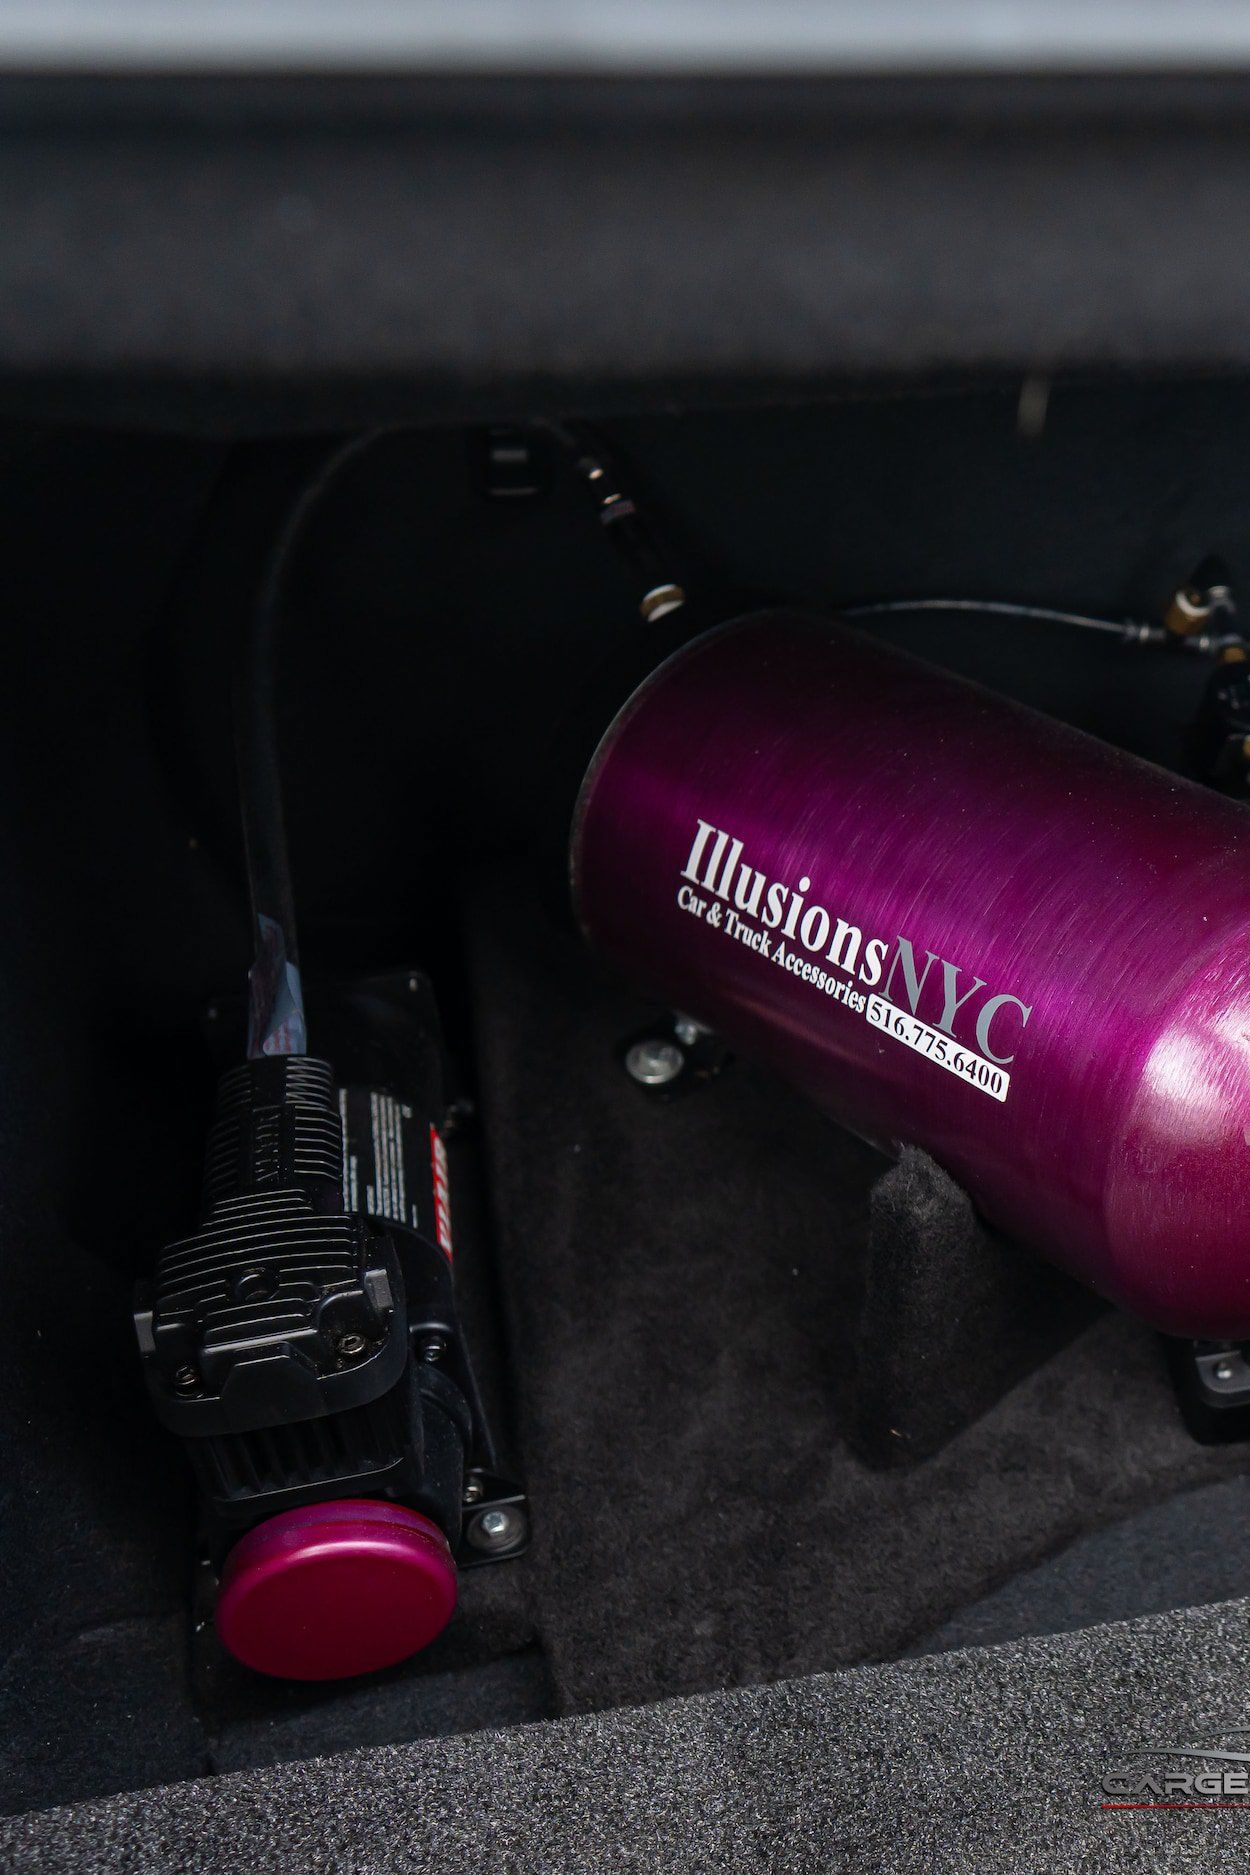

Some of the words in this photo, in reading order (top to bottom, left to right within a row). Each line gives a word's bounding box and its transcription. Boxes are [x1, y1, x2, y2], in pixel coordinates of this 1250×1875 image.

[677, 885, 706, 916] Car
[705, 900, 722, 929] &
[724, 908, 774, 959] Truck
[771, 940, 868, 1014] Accessories
[869, 1000, 1004, 1095] 516.775.6400
